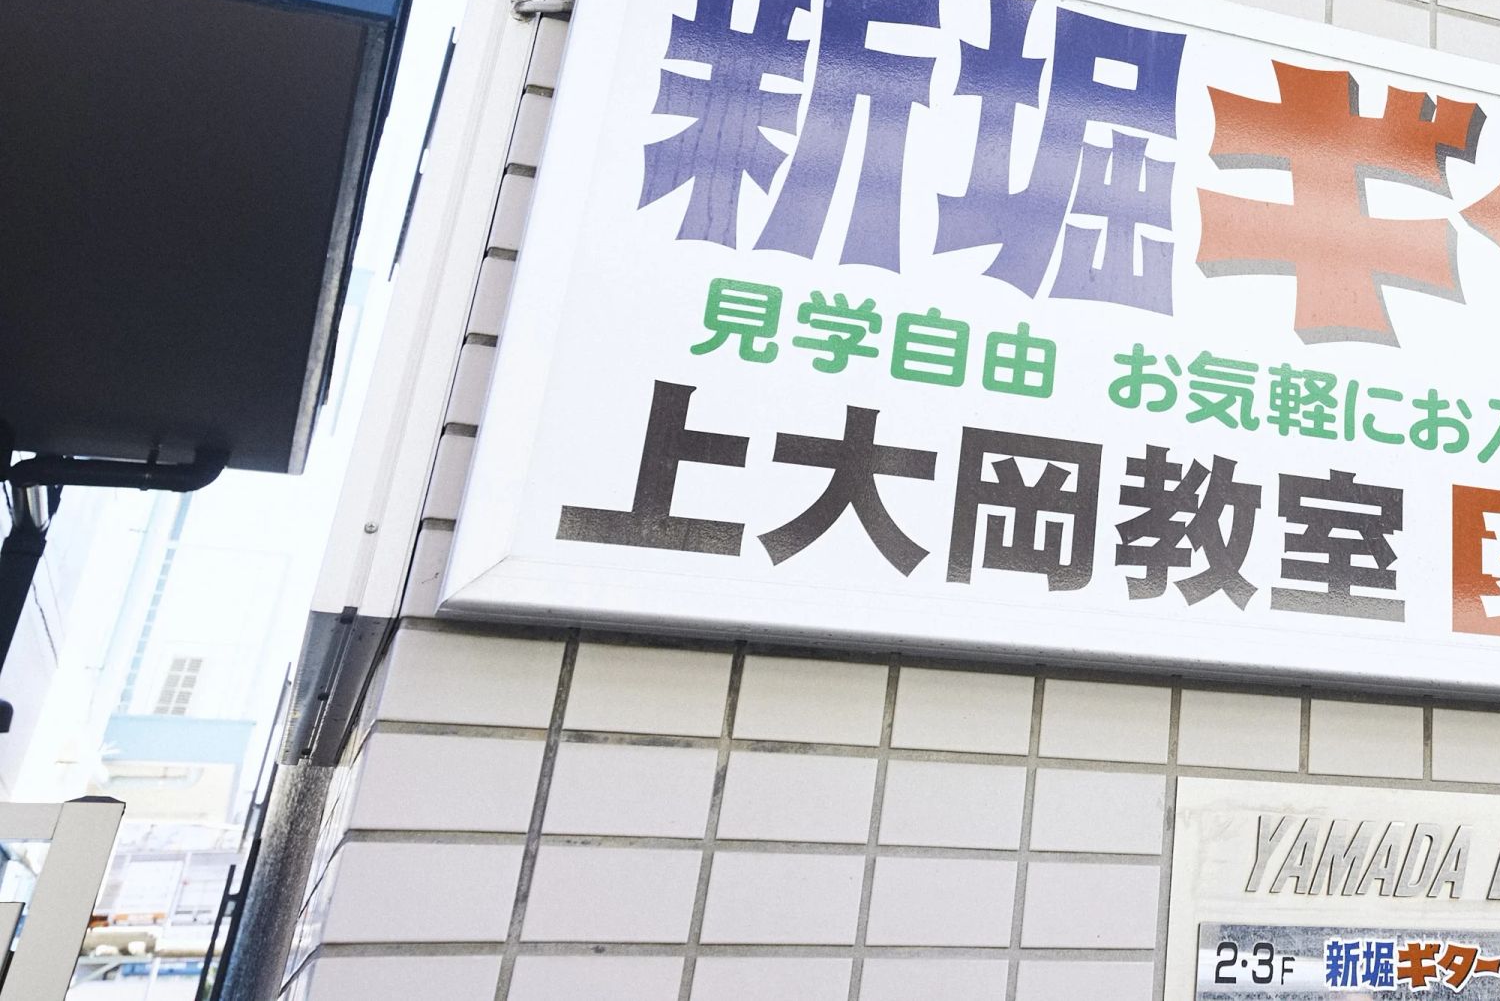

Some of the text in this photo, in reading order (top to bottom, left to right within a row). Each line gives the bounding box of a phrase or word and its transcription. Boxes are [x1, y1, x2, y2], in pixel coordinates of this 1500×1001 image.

[690, 277, 1057, 399] 見学自由
[555, 379, 1407, 623] 上大岡教室
[1245, 815, 1474, 899] YAMADA
